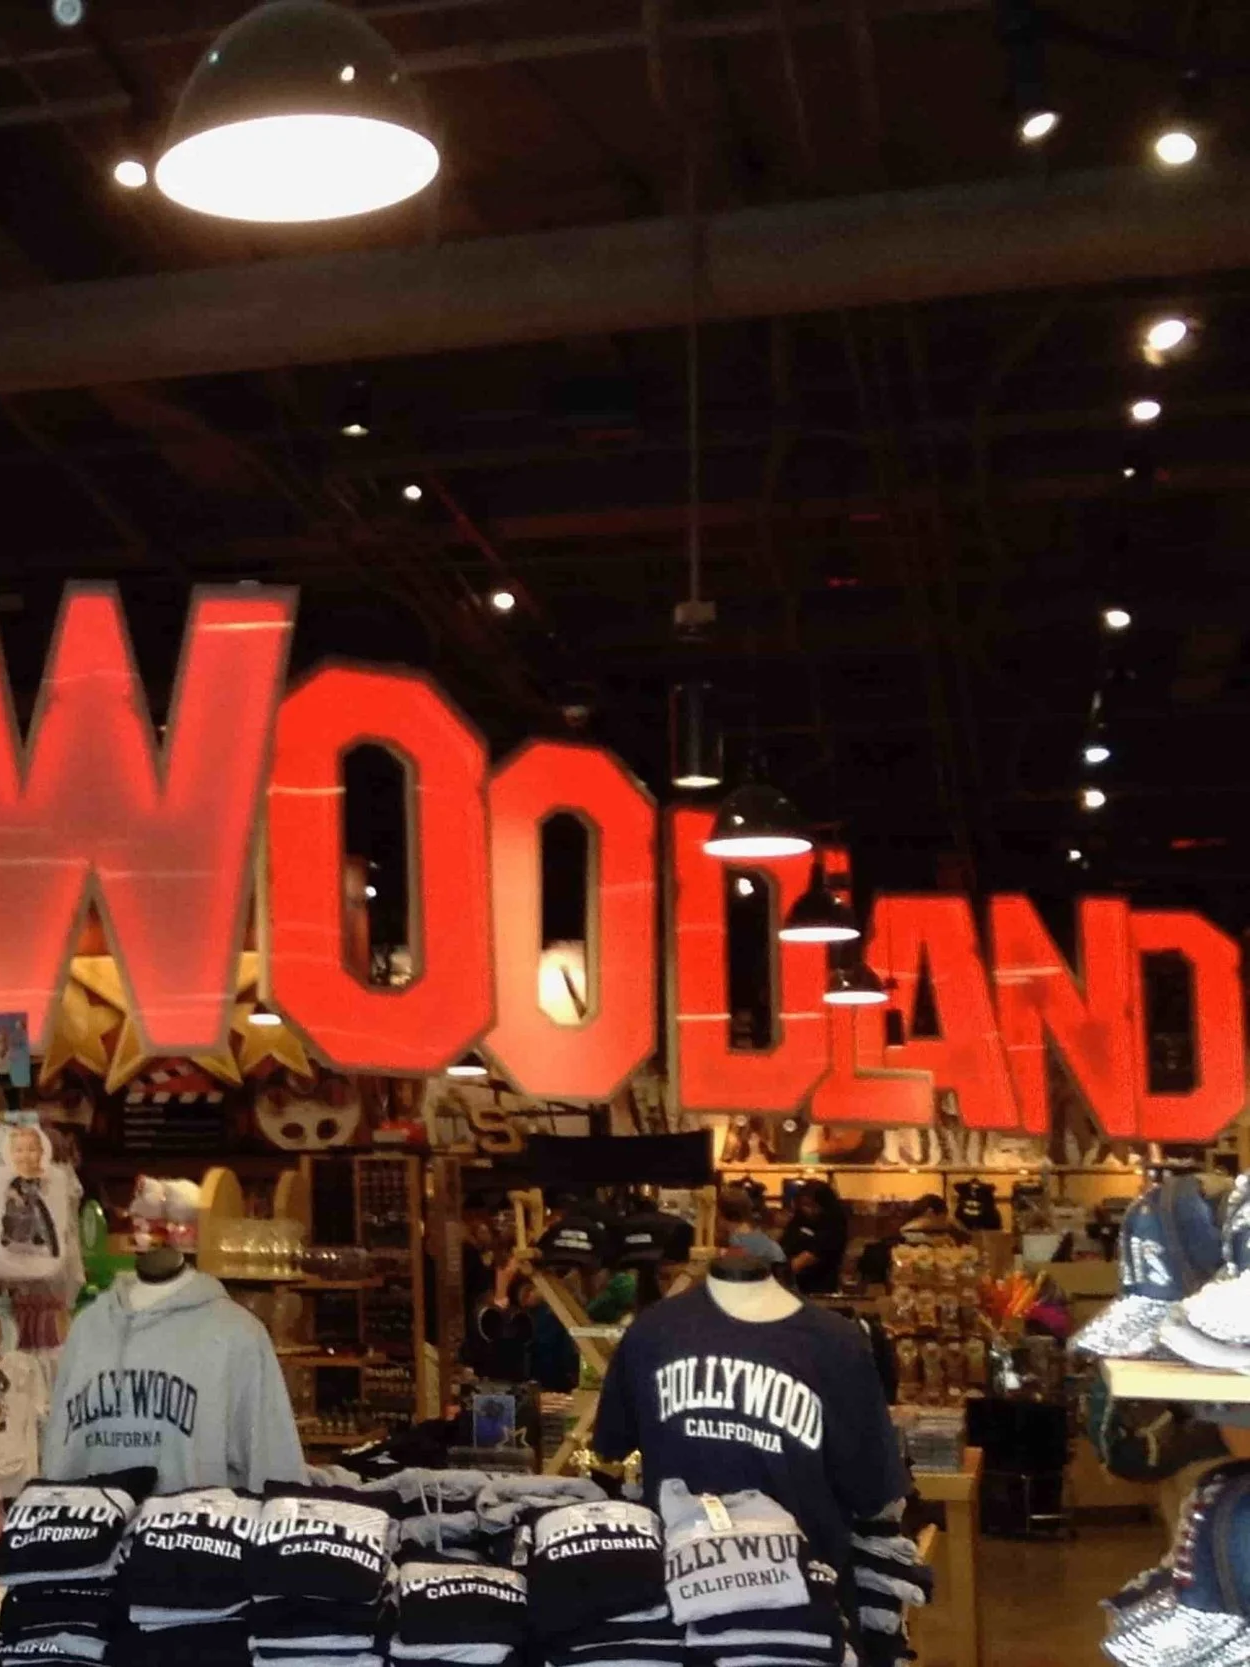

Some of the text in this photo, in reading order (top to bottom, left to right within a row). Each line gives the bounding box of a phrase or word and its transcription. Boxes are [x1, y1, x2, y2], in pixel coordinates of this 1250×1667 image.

[655, 1355, 823, 1450] HOLLYWOOD
[84, 1430, 162, 1449] CALIFORNA
[144, 1531, 243, 1560] CALIFORNIA
[280, 1540, 382, 1573] CALIFORNIA
[547, 1536, 657, 1561] CALIFORNIA
[426, 1582, 528, 1607] CALIFORNIA
[679, 1567, 791, 1600] CALIFORNIA
